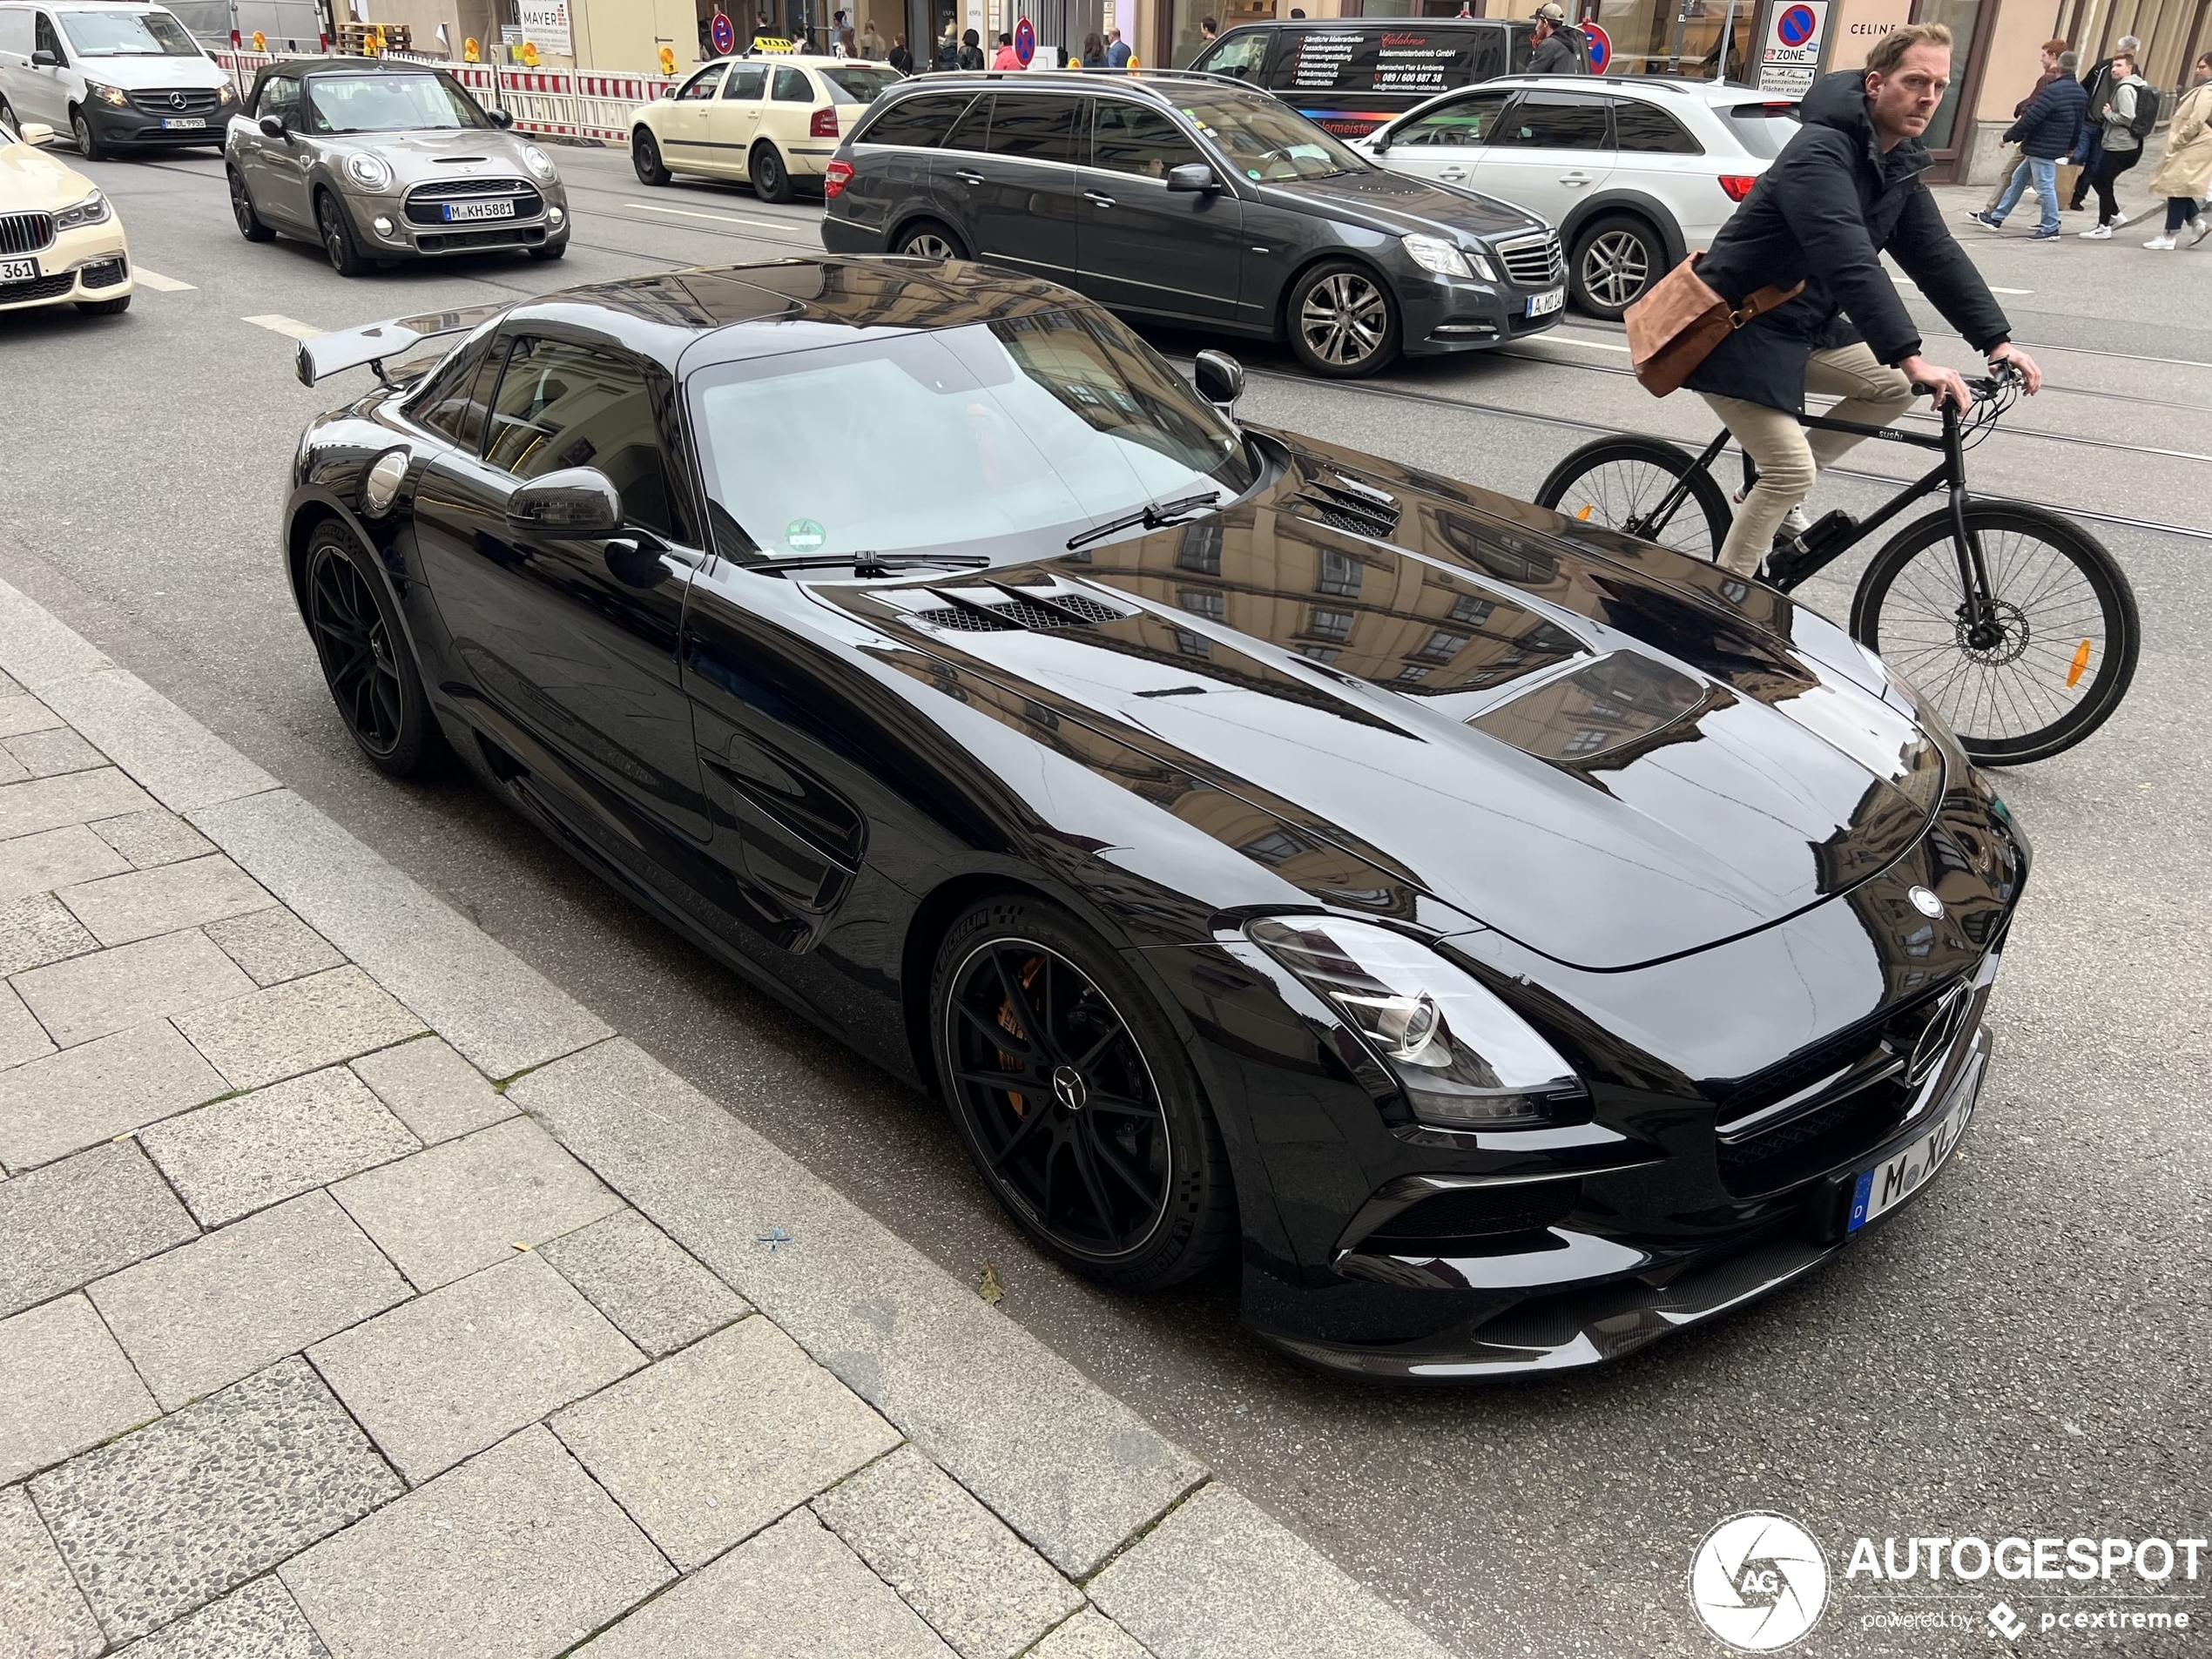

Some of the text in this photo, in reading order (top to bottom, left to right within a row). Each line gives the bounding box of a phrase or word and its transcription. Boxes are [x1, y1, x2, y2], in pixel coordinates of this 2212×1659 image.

[523, 11, 557, 25] MAYER
[1381, 32, 1425, 47] Calabrese
[1777, 50, 1805, 60] ZONE
[1382, 73, 1396, 82] 089
[1401, 73, 1416, 82] 600
[1416, 73, 1431, 83] 887
[1431, 73, 1442, 83] 38
[1321, 121, 1373, 133] lermeister
[452, 206, 460, 218] M
[485, 203, 512, 216] 5881
[3, 263, 33, 279] 361
[1878, 430, 1904, 441] sushi
[1881, 1151, 1908, 1207] M
[1854, 1205, 1863, 1218] D
